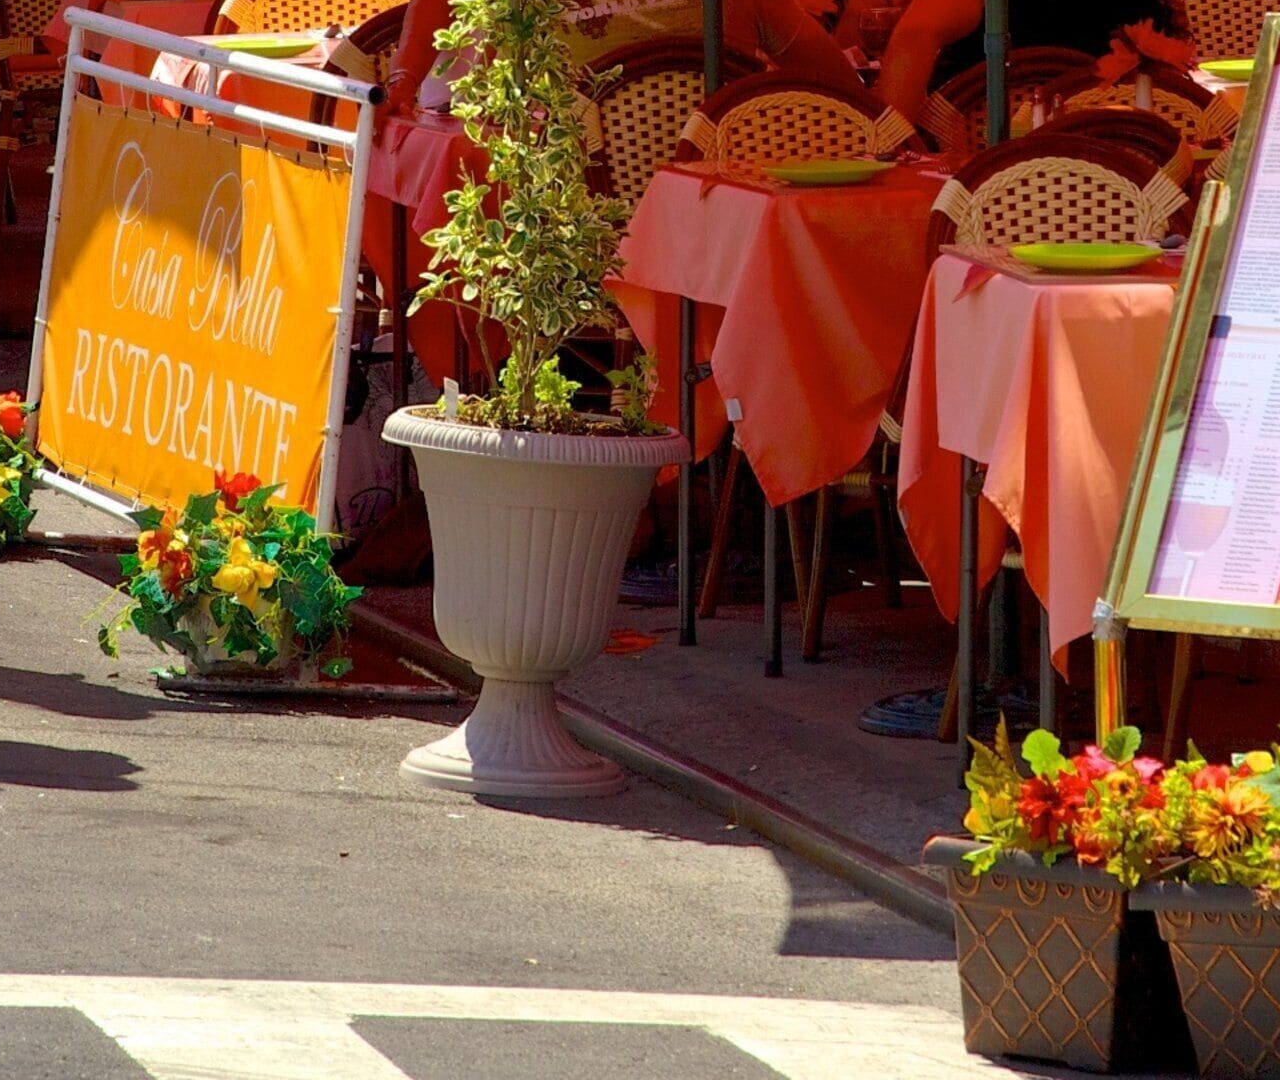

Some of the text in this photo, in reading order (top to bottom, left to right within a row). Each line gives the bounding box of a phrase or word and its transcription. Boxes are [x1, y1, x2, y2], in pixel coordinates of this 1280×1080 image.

[111, 141, 284, 356] Casa Bella
[66, 328, 298, 499] RISTORANTE
